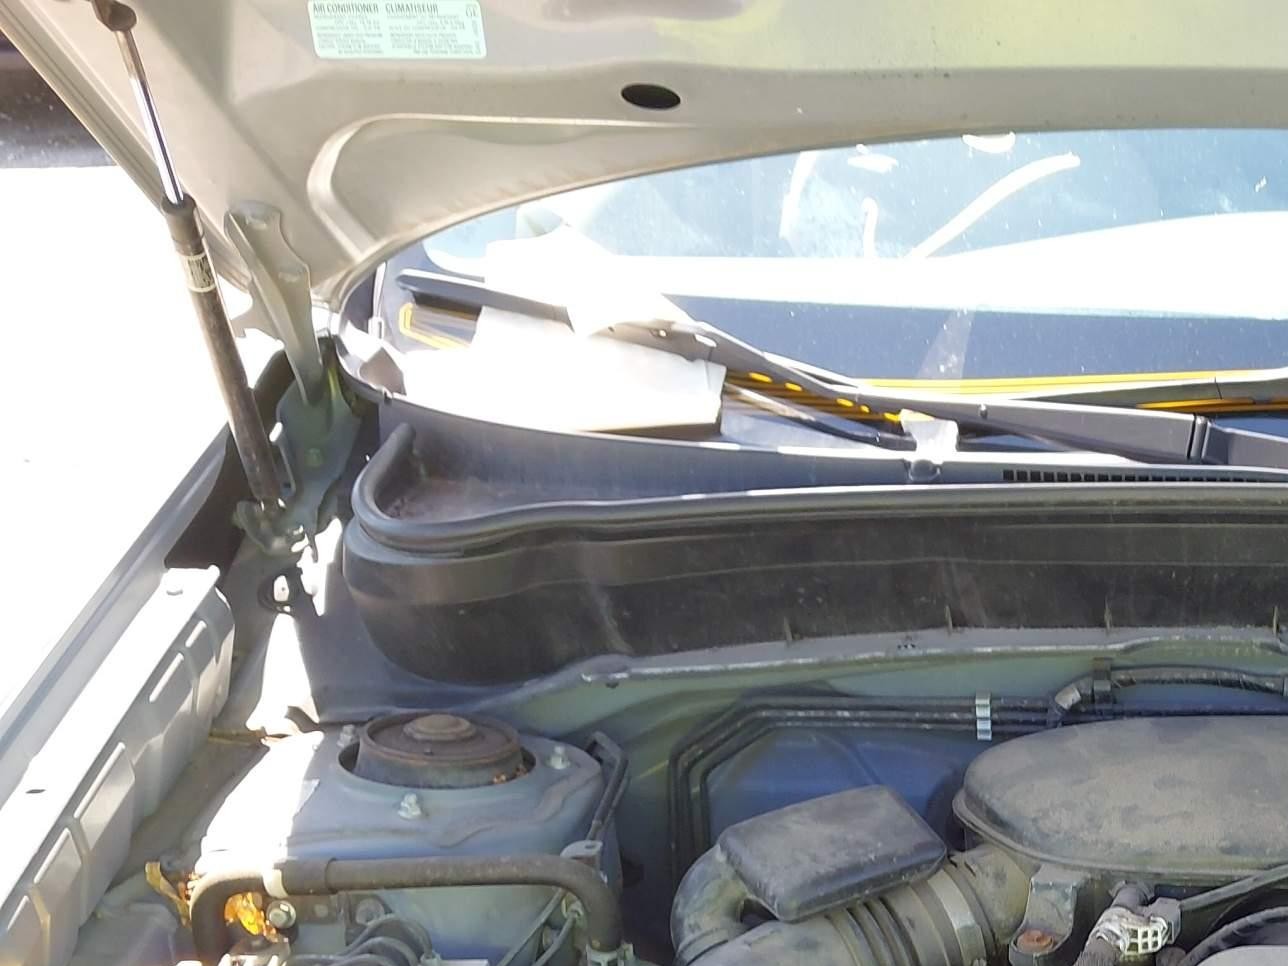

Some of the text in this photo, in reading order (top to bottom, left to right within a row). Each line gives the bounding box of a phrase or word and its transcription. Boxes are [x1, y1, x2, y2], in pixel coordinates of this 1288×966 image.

[312, 2, 378, 14] AIR CONDITIONER
[385, 2, 438, 15] CLIMATISEUR
